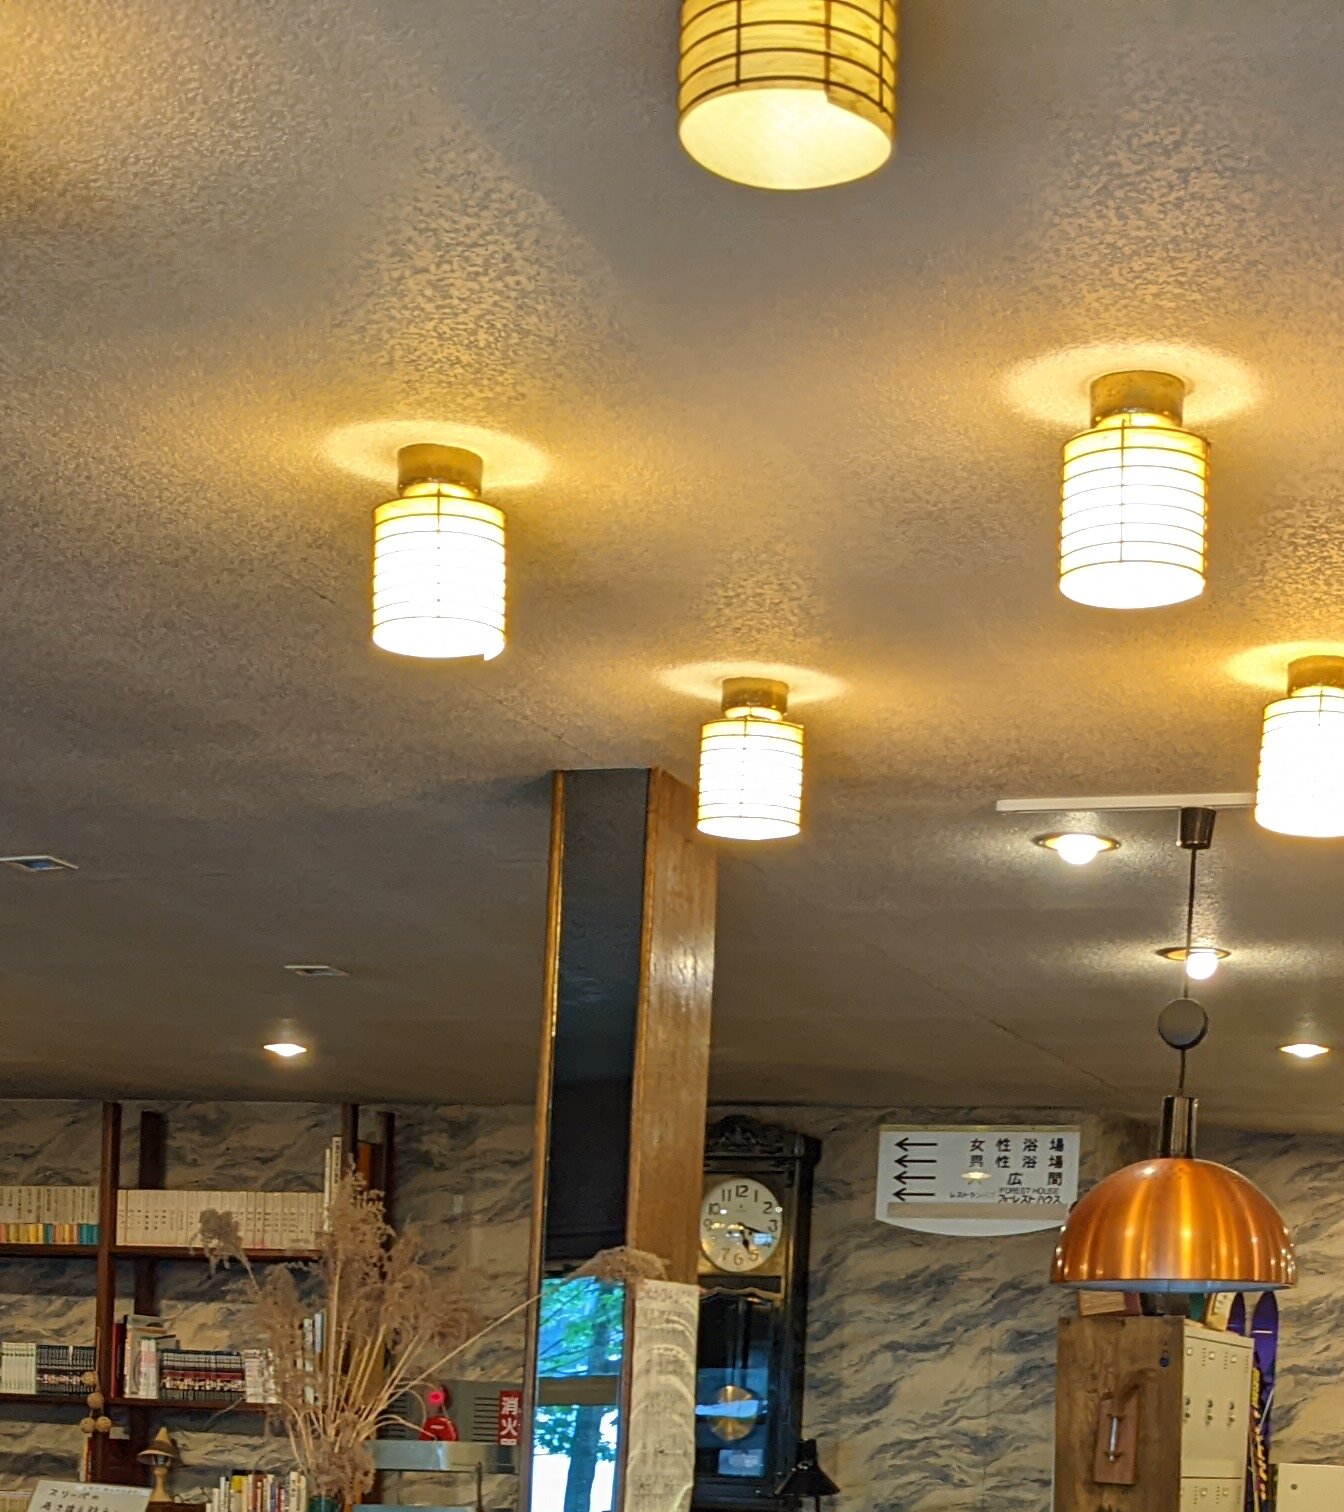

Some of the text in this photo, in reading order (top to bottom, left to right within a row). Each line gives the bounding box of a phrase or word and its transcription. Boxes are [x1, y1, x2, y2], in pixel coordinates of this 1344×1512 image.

[969, 1137, 1065, 1153] 女性浴場
[968, 1154, 1064, 1170] 男性浴場
[722, 1189, 731, 1202] 11
[735, 1184, 749, 1198] 12
[763, 1201, 773, 1215] 2
[768, 1219, 778, 1233] 3
[733, 1252, 744, 1266] 6
